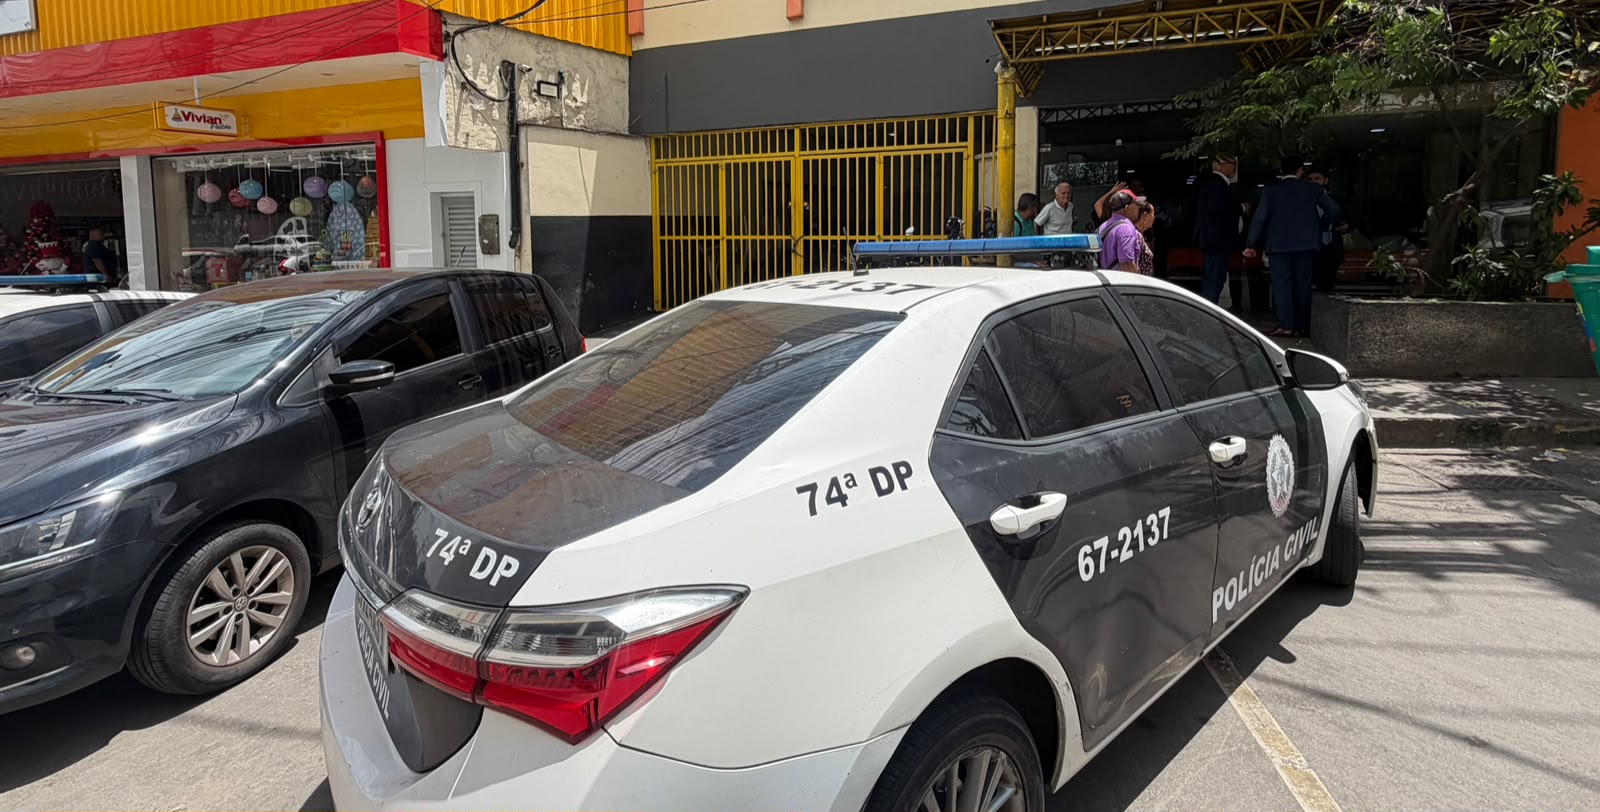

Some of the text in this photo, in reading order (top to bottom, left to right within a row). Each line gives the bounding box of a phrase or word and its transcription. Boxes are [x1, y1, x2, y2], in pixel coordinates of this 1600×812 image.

[181, 110, 222, 125] Vivian
[868, 460, 913, 498] DP
[469, 546, 520, 586] DP
[1077, 506, 1171, 582] 67-2137
[1212, 516, 1319, 624] POLÍCIA CIVIL
[372, 662, 390, 720] CIVIL
